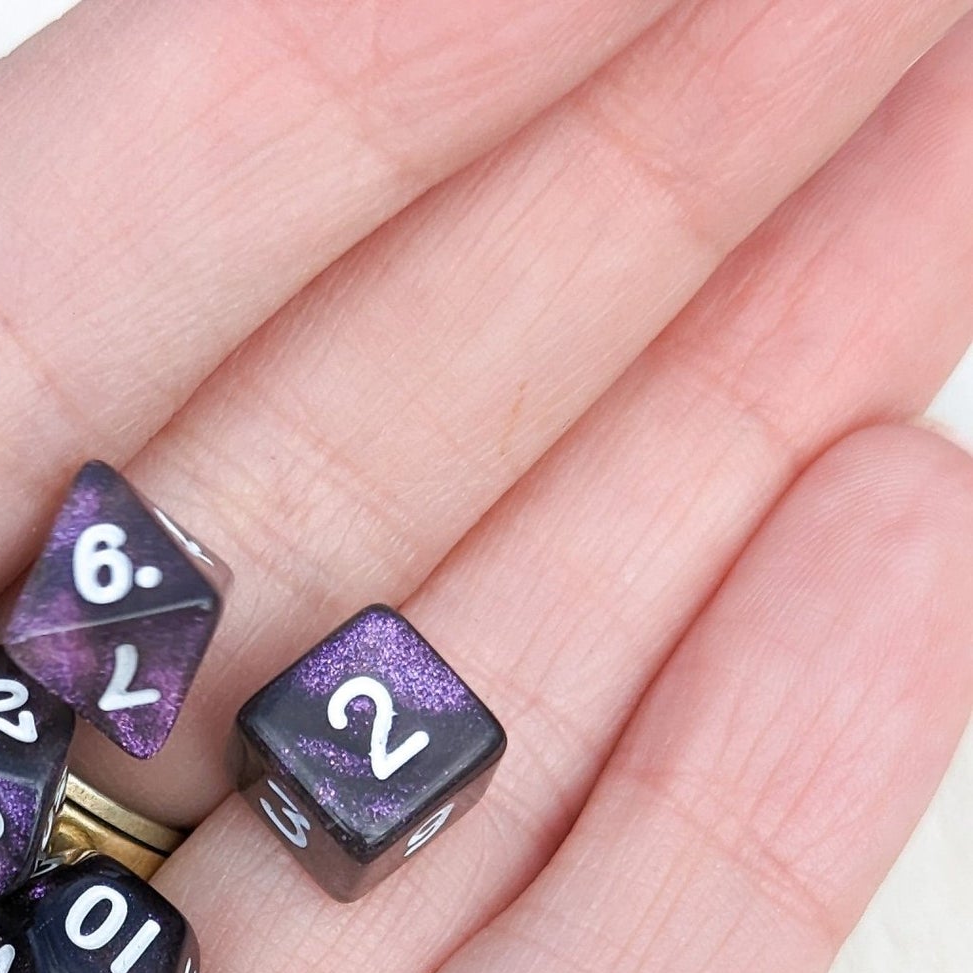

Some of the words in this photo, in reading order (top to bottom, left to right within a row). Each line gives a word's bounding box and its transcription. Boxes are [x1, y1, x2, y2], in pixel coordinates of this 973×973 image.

[97, 643, 162, 712] 7
[328, 676, 430, 780] 2
[259, 779, 311, 848] 3
